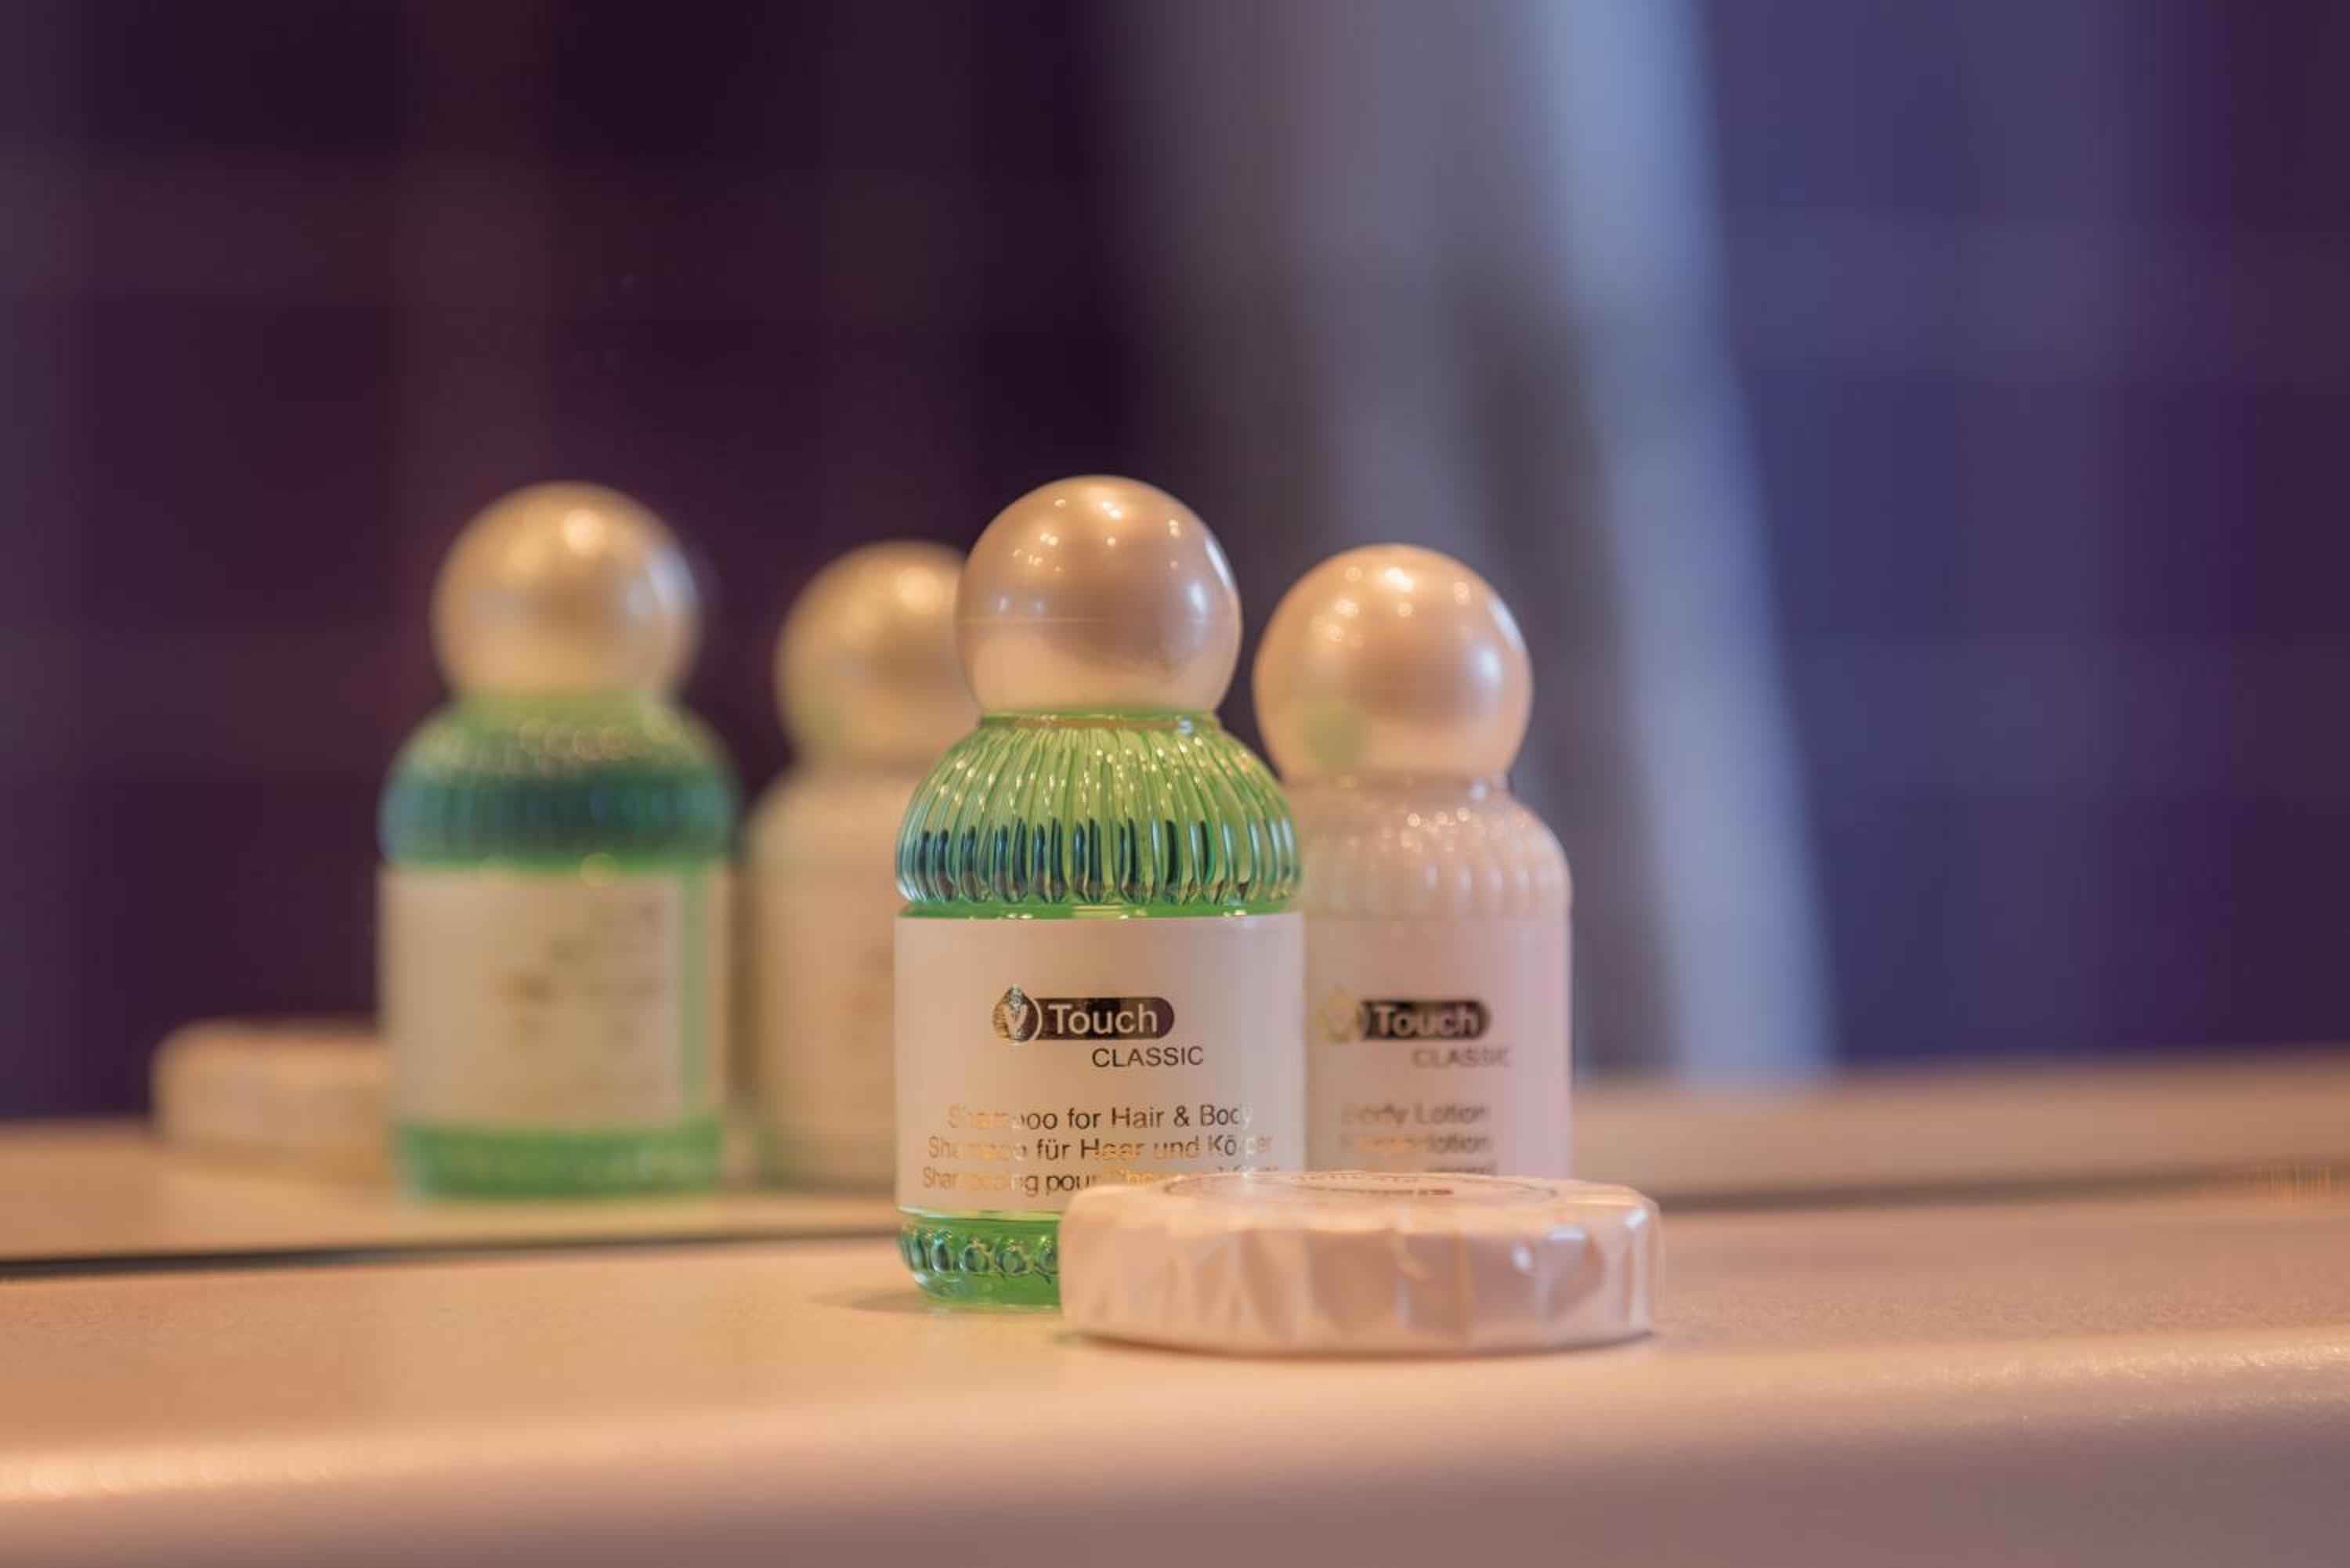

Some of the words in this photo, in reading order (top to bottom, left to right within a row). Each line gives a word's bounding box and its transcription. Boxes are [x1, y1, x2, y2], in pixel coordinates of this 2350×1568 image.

[1047, 1003, 1159, 1035] Touch
[1374, 1004, 1480, 1037] Touch
[1091, 1046, 1205, 1068] CLASSIC
[1067, 1107, 1101, 1130] for
[1112, 1106, 1166, 1129] Hair
[1174, 1104, 1190, 1128] &
[1037, 1138, 1071, 1161] für
[1080, 1138, 1145, 1162] Haar
[1152, 1136, 1200, 1159] und
[1207, 1134, 1273, 1158] Köper
[1046, 1174, 1098, 1197] pou
